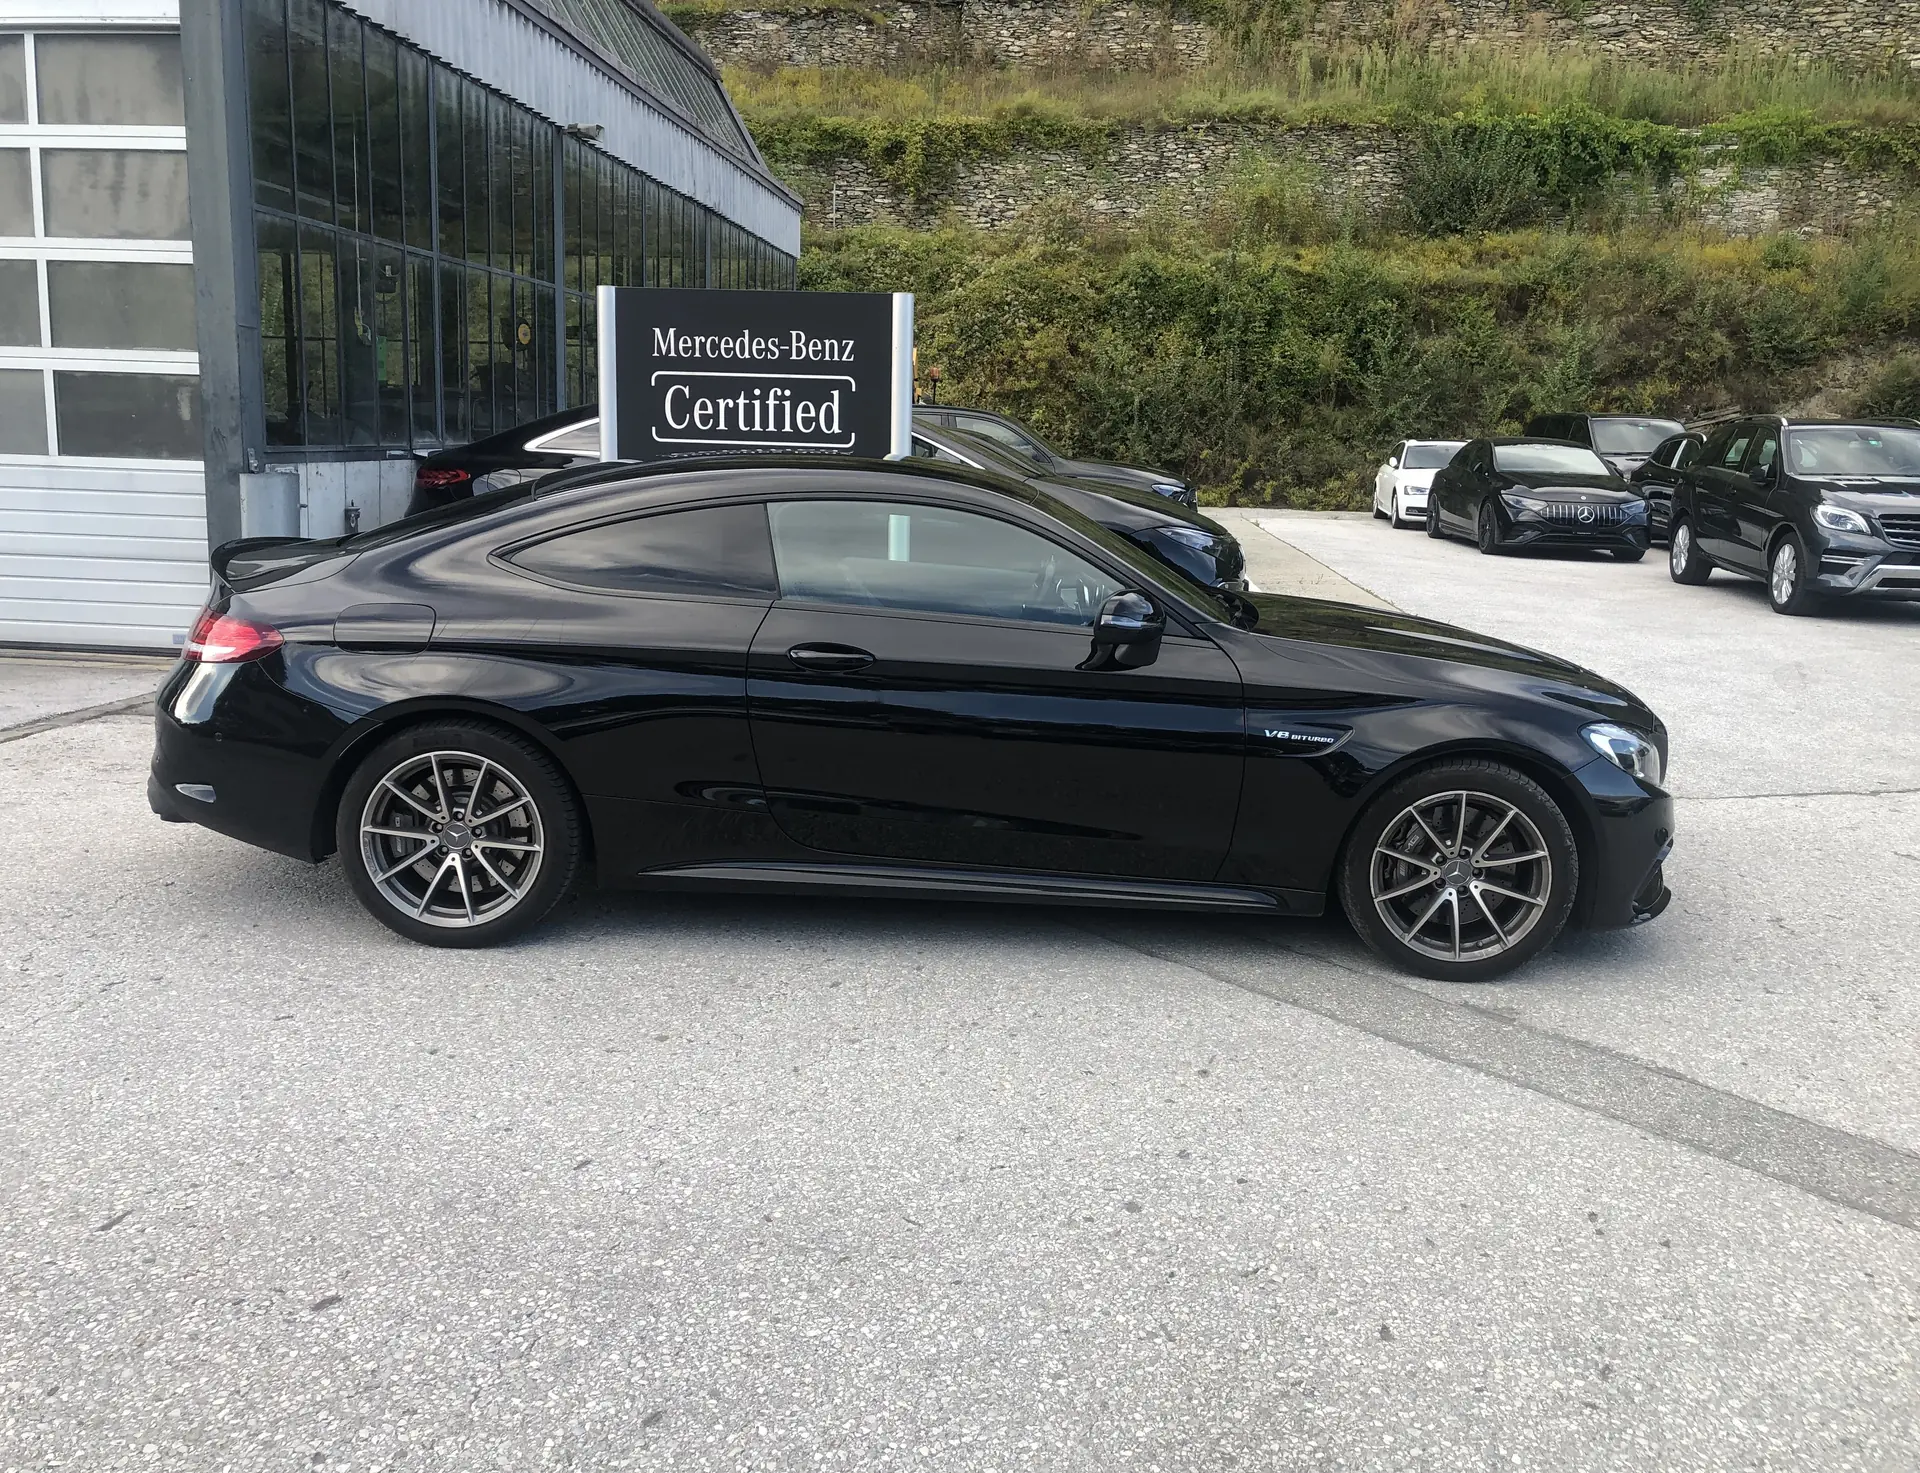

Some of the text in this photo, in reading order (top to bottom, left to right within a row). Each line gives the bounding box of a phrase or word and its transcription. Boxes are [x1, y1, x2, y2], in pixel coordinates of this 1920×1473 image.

[652, 327, 855, 362] Mercedes-Benz
[664, 384, 843, 434] Certified
[1264, 729, 1335, 744] V8 BITURBO
